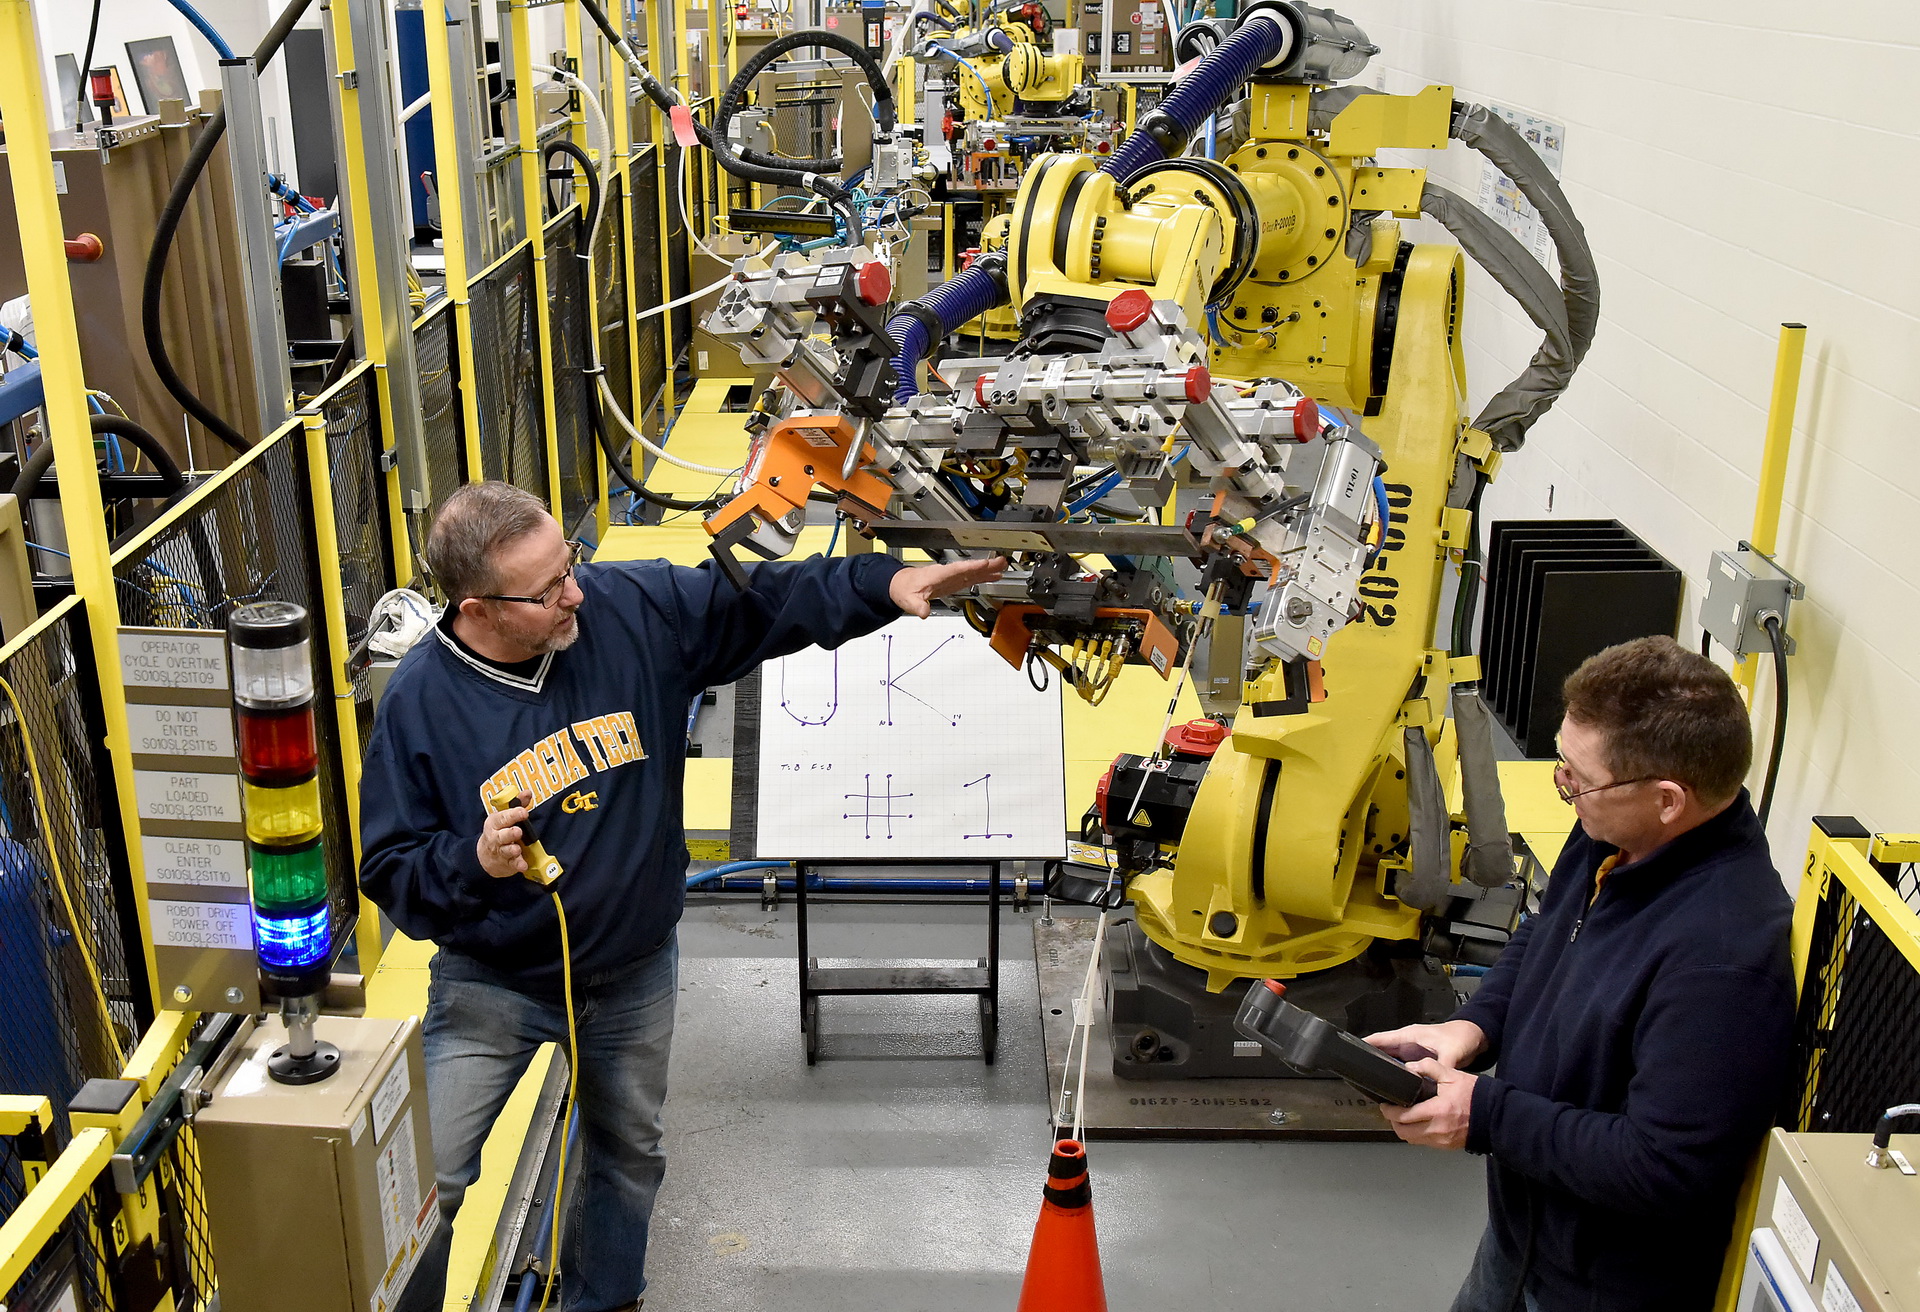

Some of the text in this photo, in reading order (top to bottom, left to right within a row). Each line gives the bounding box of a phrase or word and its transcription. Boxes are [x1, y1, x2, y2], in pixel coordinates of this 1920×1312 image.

[1345, 468, 1359, 498] CYL-01
[141, 640, 201, 654] OPERATOR
[124, 654, 221, 670] CYCLE OVERTIME
[156, 710, 199, 723] DO NOT
[162, 724, 199, 737] ENTER
[571, 711, 645, 773] TECH
[170, 776, 200, 789] PART
[166, 790, 209, 803] LOADED
[164, 841, 222, 856] CLEAR TO
[176, 855, 212, 868] ENTER
[1806, 853, 1816, 877] 2
[1820, 870, 1829, 894] 2
[166, 904, 239, 920] ROBOT DRIVE
[172, 918, 235, 932] POWER OFF
[116, 1219, 125, 1246] 8
